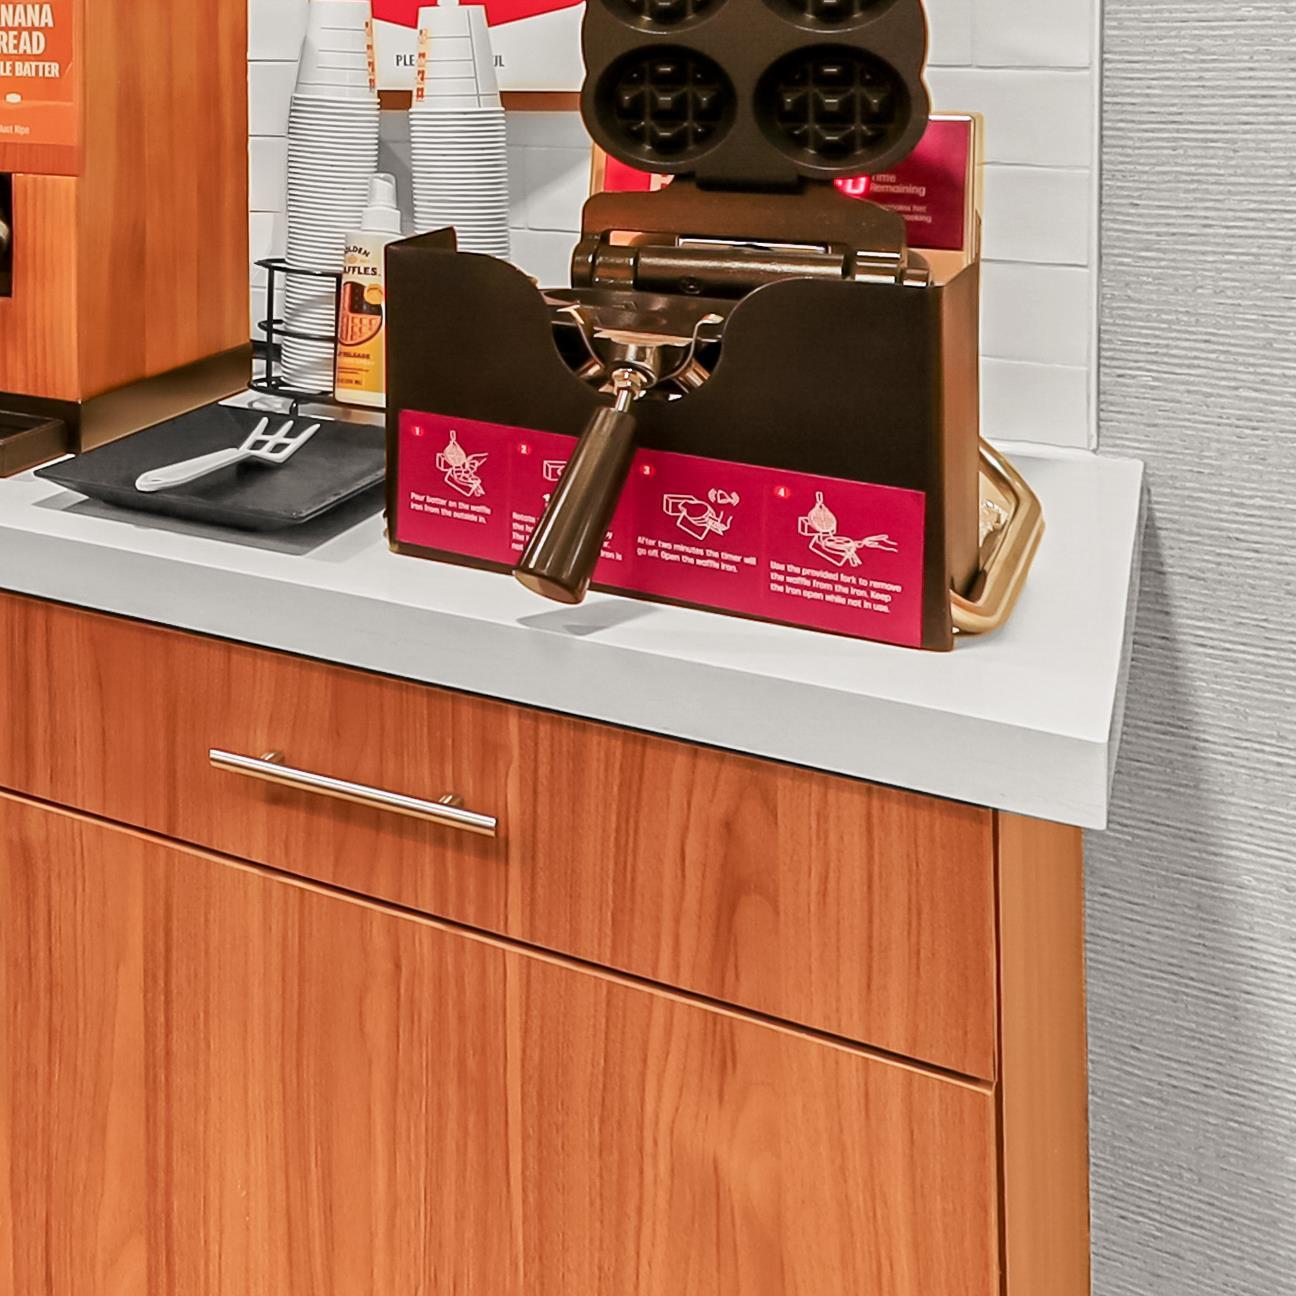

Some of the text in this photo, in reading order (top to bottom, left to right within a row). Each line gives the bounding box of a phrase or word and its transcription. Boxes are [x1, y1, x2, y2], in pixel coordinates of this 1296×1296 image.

[14, 60, 60, 79] BATTER
[869, 182, 927, 197] Remaining
[414, 426, 421, 437] 1
[520, 444, 528, 455] 2
[643, 465, 650, 475] 3
[777, 487, 786, 497] 4
[424, 504, 440, 515] from
[440, 507, 452, 517] the
[637, 535, 656, 546] After
[657, 539, 672, 550] two
[705, 548, 720, 559] the
[660, 551, 681, 562] Open
[681, 555, 695, 565] the
[769, 560, 903, 593] Use the provided fork to remove
[769, 571, 785, 582] the
[812, 579, 833, 591] from
[834, 583, 849, 594] the
[870, 589, 892, 603] Keep
[769, 582, 785, 593] the
[785, 585, 802, 596] iron
[802, 588, 824, 601] open
[824, 592, 847, 605] while
[847, 597, 862, 608] not
